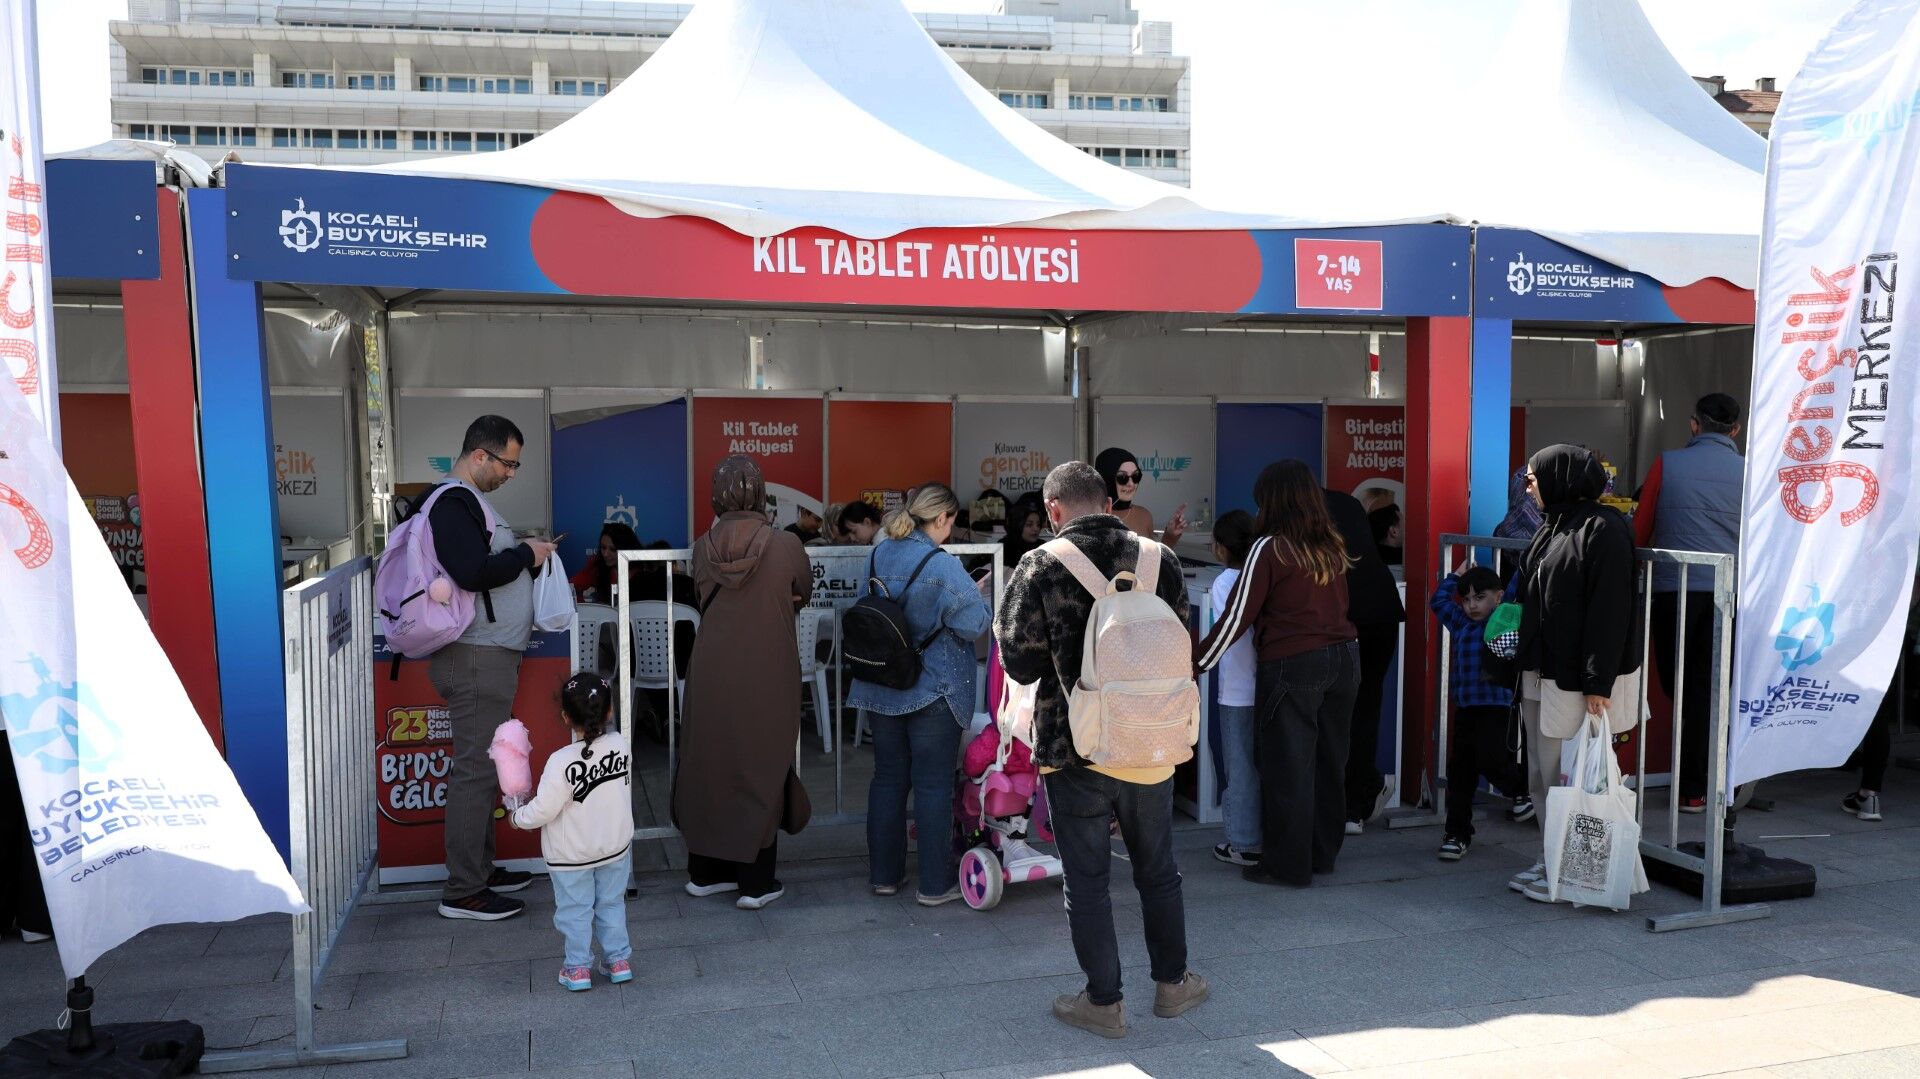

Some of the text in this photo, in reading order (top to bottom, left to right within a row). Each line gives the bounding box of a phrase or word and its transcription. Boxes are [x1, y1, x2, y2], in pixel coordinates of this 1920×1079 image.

[379, 250, 418, 258] OLUYOR
[814, 238, 933, 278] TABLET
[943, 235, 1079, 283] ATÖLYESİ
[1316, 254, 1361, 277] 7-14
[1325, 277, 1353, 294] YAŞ
[1841, 251, 1899, 450] MERKEZİ
[1778, 262, 1880, 528] gençlik
[723, 421, 799, 436] Kil Tablet
[1345, 419, 1405, 436] Birleşti
[728, 438, 794, 456] Atölyesi
[979, 450, 1050, 490] gençlik
[1346, 453, 1405, 472] Atölyes
[391, 710, 428, 741] 23
